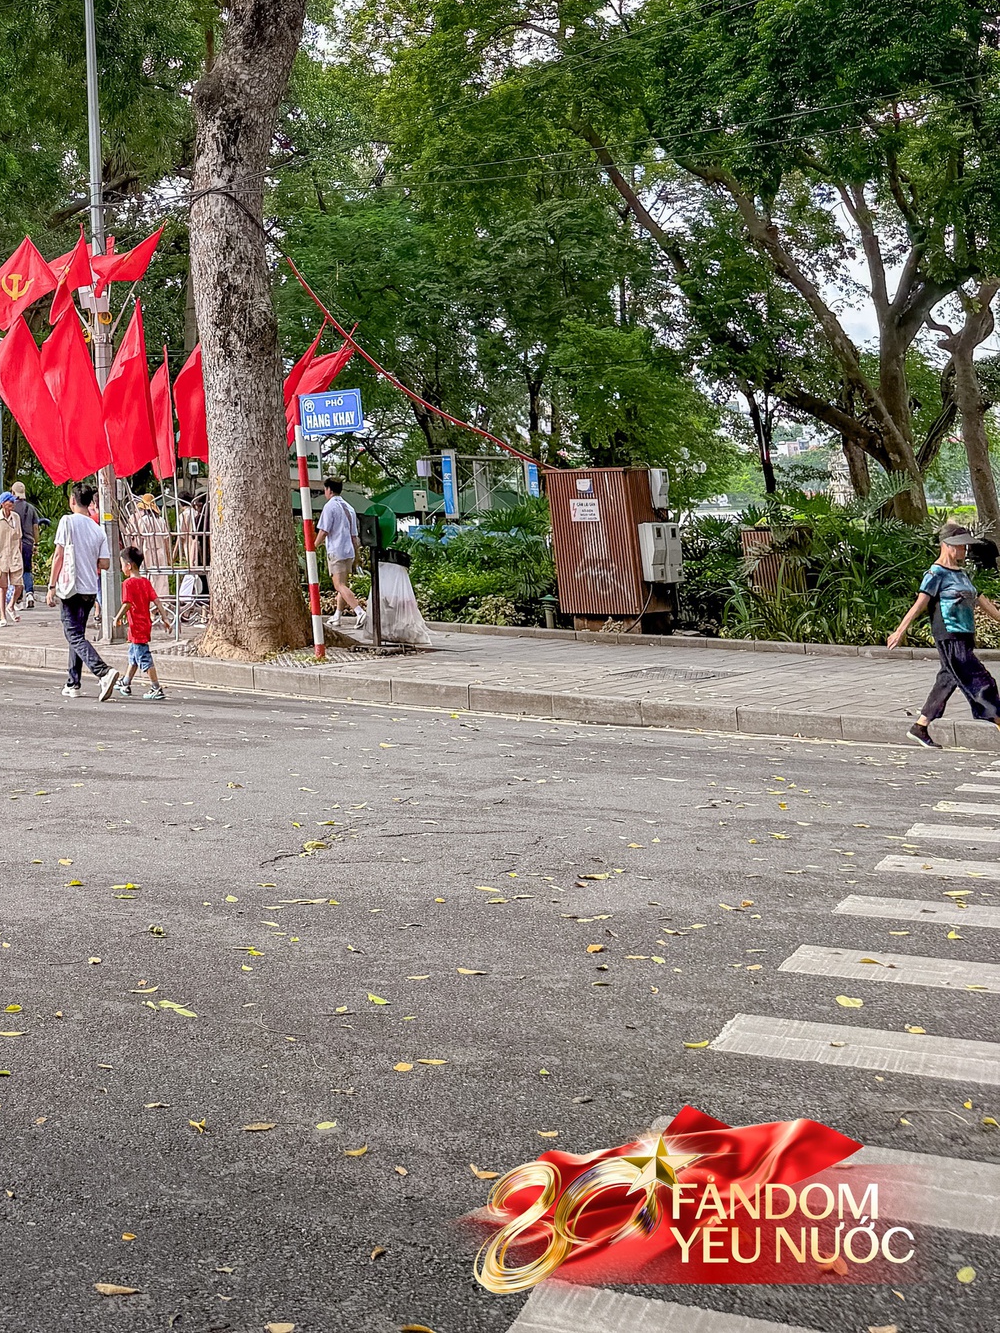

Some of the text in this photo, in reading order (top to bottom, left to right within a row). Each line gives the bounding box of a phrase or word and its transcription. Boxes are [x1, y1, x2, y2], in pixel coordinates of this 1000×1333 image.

[325, 395, 344, 408] PHỐ
[306, 411, 355, 429] HÀNG KHAY
